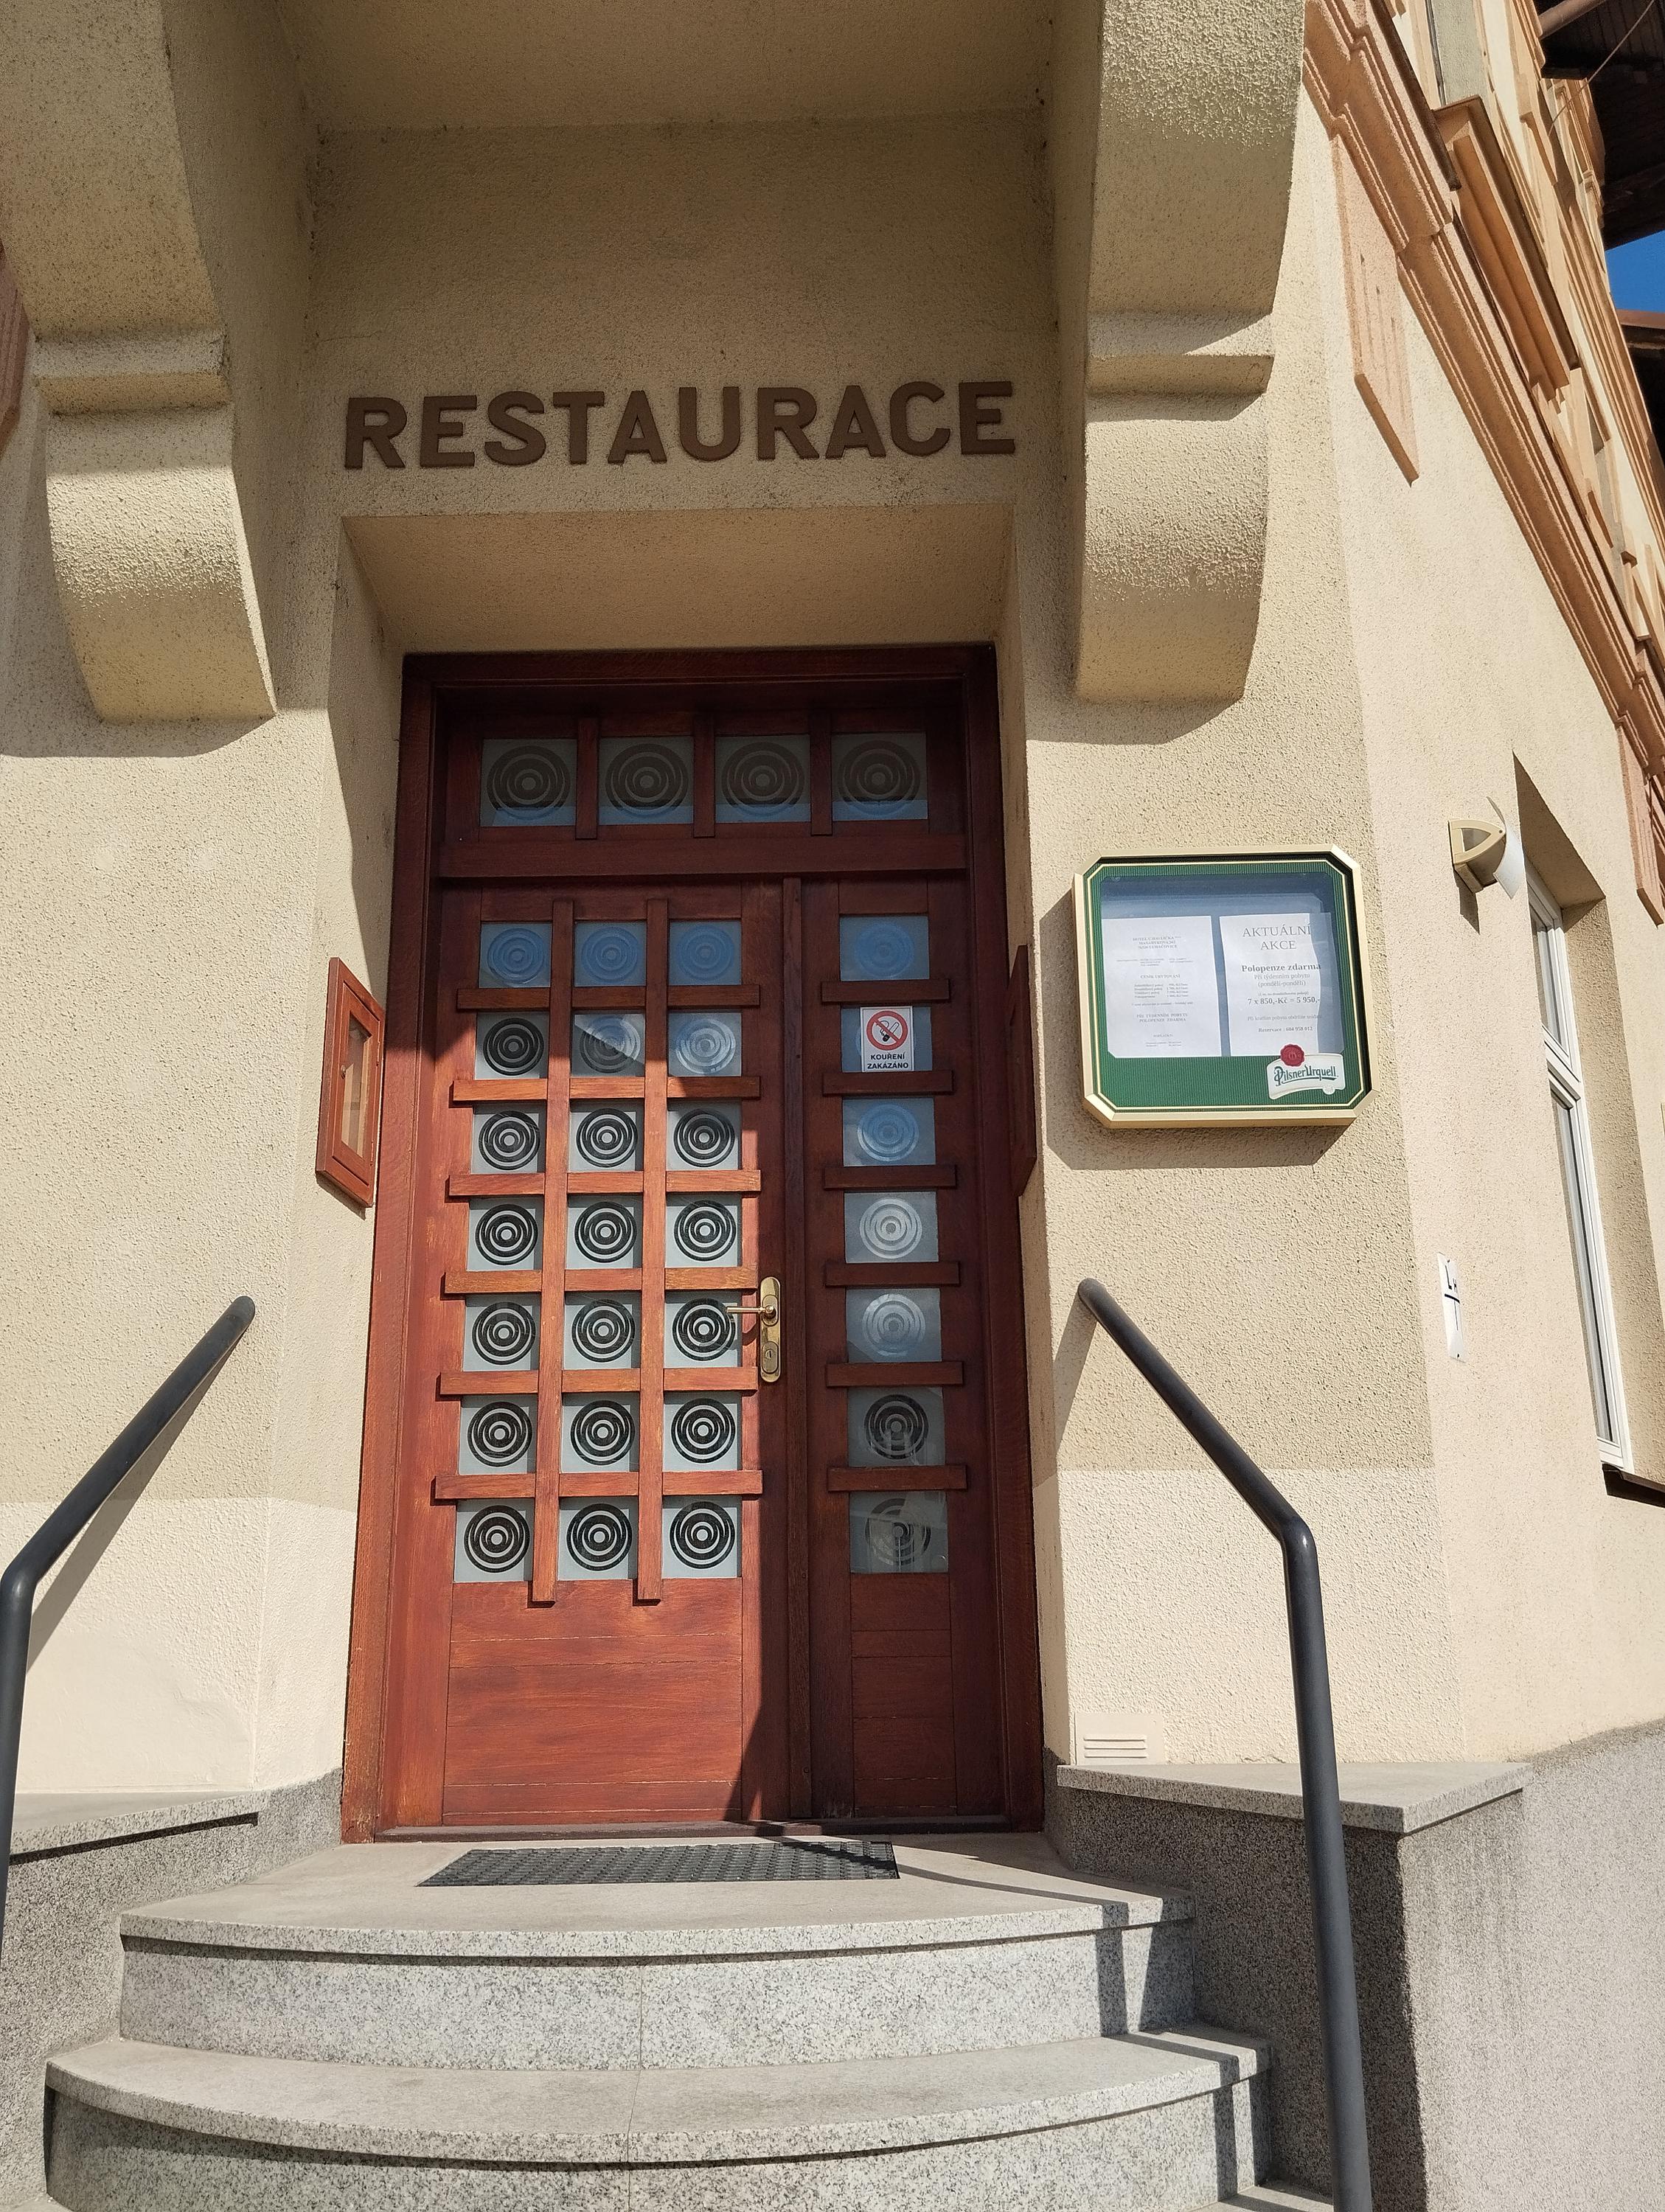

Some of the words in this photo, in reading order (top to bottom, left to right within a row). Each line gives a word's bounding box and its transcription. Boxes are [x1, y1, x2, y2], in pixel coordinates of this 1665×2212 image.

[344, 380, 1015, 470] RESTAURACE
[1242, 923, 1311, 937] AKTUÁLNÍ
[1260, 940, 1297, 950] AKCE
[1242, 964, 1286, 973] Polopenze
[871, 1052, 905, 1060] KOUŘENÍ
[867, 1061, 908, 1069] ZAKÁZÁNO
[1273, 1065, 1305, 1087] Pilsner
[1304, 1064, 1337, 1081] Urquell
